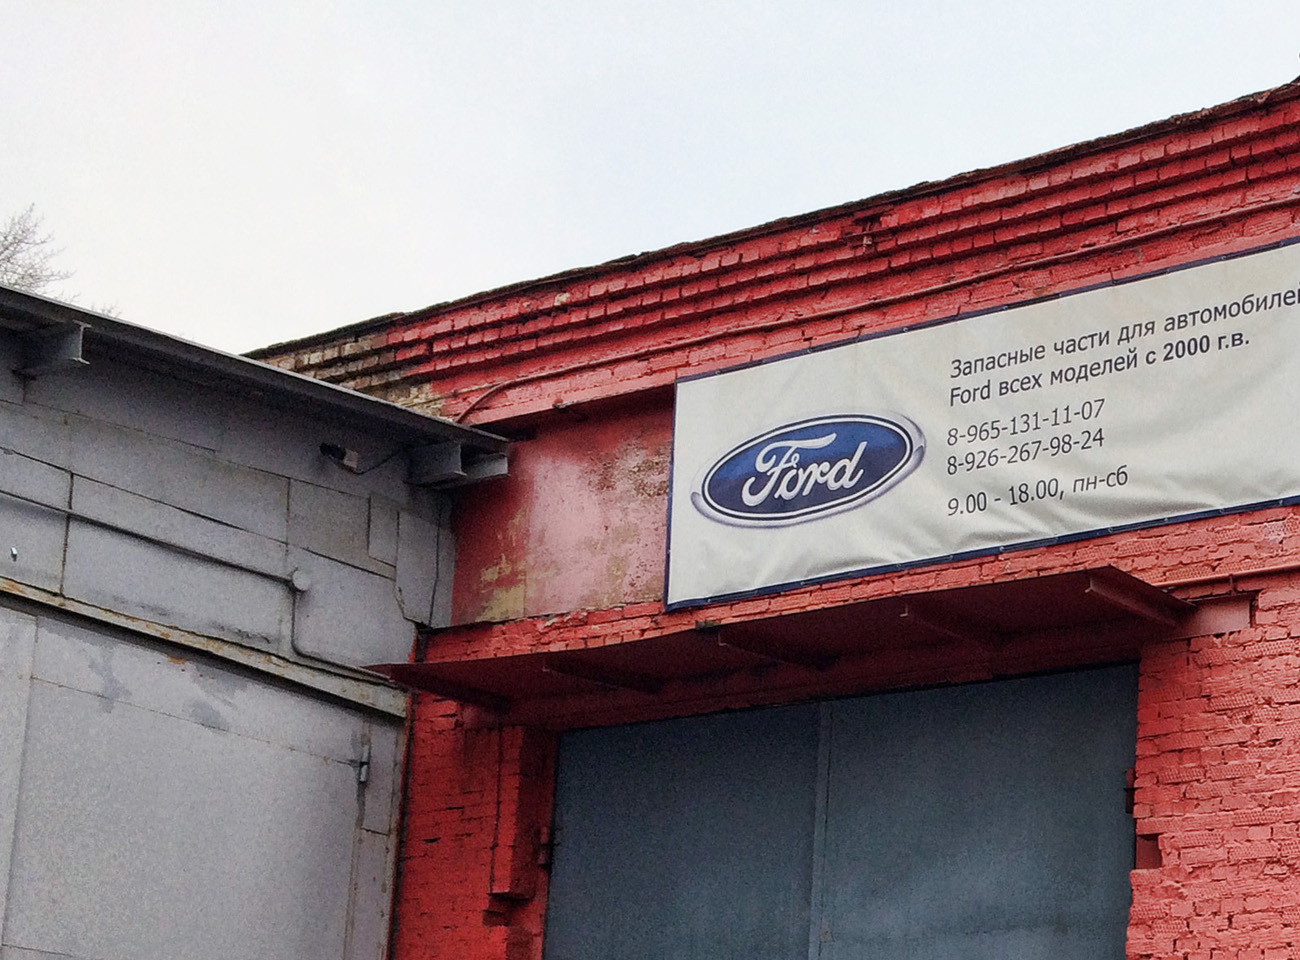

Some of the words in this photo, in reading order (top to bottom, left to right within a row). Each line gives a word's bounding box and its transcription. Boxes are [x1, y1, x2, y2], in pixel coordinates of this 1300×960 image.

[950, 344, 1046, 379] Запасные
[1053, 330, 1110, 356] части
[1116, 320, 1156, 346] для
[950, 379, 991, 408] Ford
[998, 372, 1043, 397] всех
[1050, 346, 1138, 387] моделей
[1145, 350, 1157, 365] с
[1162, 335, 1211, 362] 2000
[1217, 332, 1250, 351] г.в.
[946, 398, 1106, 447] 8-965-131-11-07
[742, 433, 865, 508] Ford
[946, 427, 1105, 477] 8-926-267-98-24
[947, 491, 987, 517] 9.00
[1008, 477, 1065, 506] 18.00,
[1072, 464, 1129, 493] пн-сб
